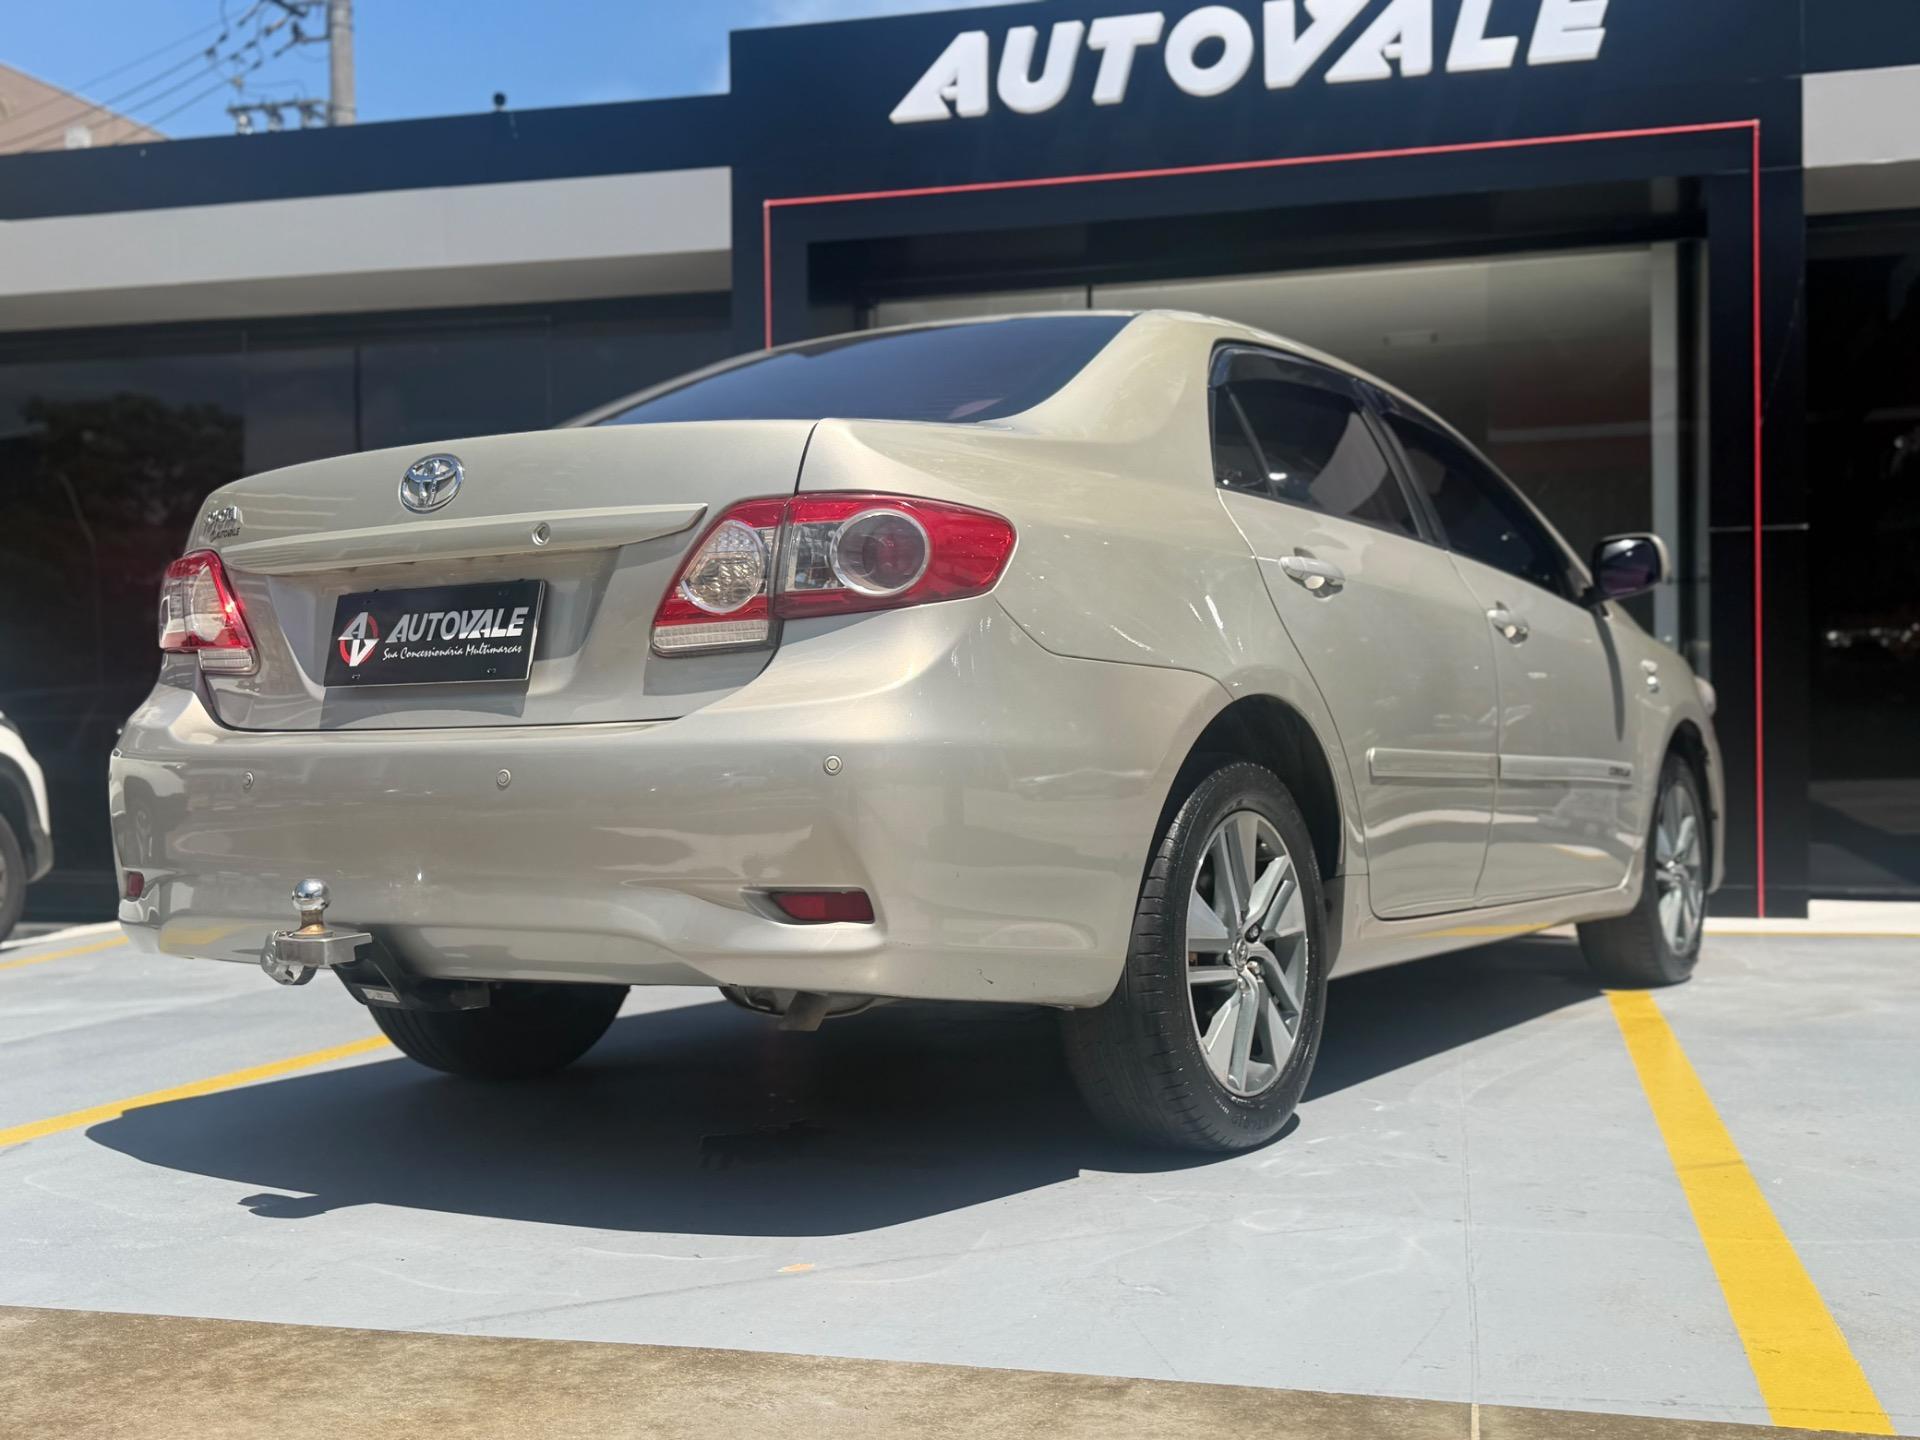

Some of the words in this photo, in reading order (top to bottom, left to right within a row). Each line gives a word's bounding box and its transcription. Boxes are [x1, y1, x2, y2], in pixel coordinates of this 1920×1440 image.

[889, 0, 1609, 123] AUTOVALE
[385, 607, 530, 643] AUTOVALE
[382, 647, 398, 660] Sua
[465, 642, 523, 657] Multimarcas
